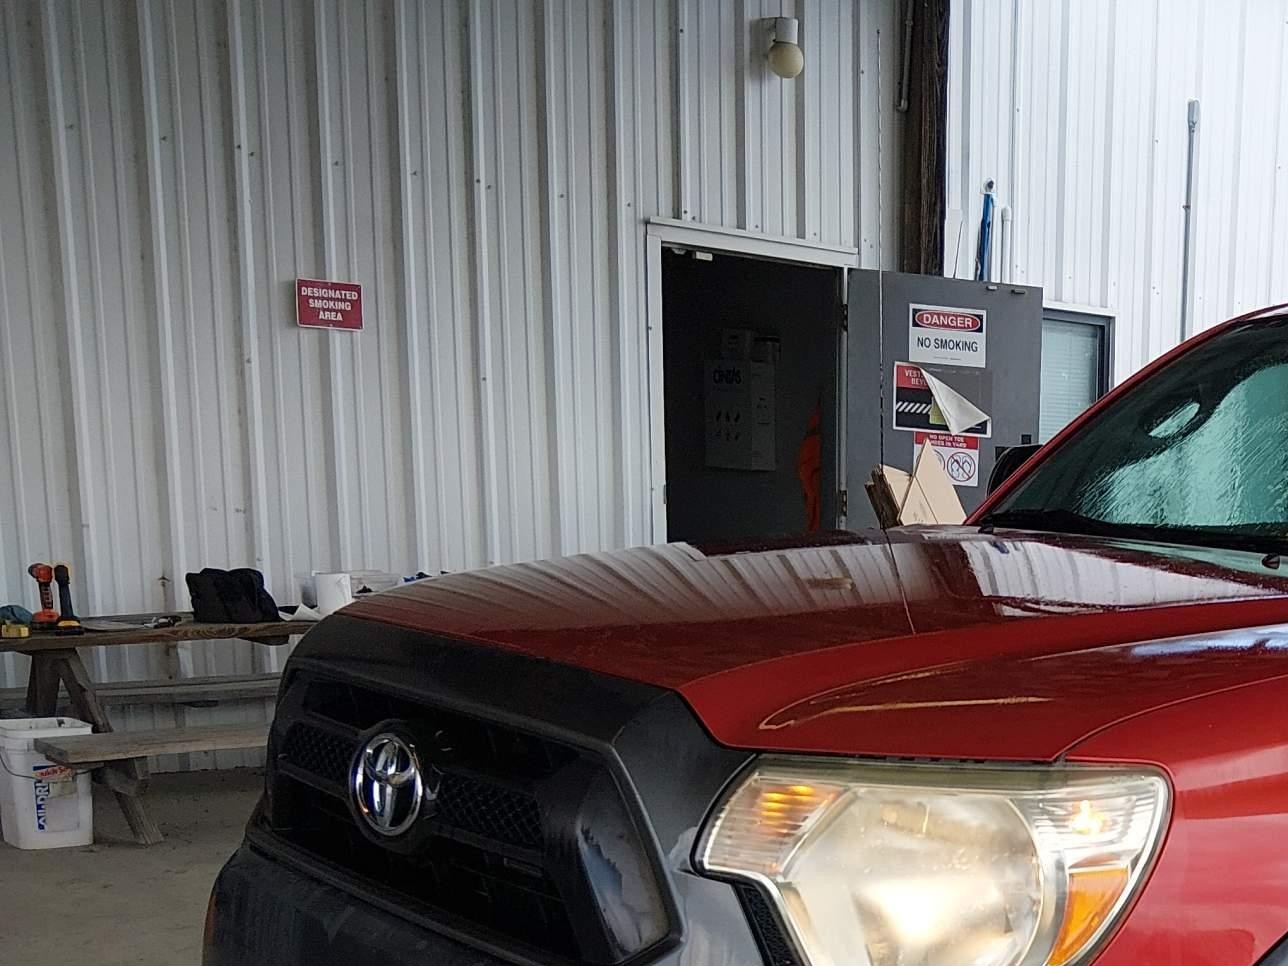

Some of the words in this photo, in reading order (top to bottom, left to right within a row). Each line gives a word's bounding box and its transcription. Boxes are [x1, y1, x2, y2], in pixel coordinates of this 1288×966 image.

[301, 286, 358, 300] DESIGNATED
[308, 298, 352, 311] SMOKING
[318, 311, 344, 321] AREA
[923, 313, 973, 328] DANGER
[917, 336, 931, 349] NO
[933, 337, 978, 353] SMOKING
